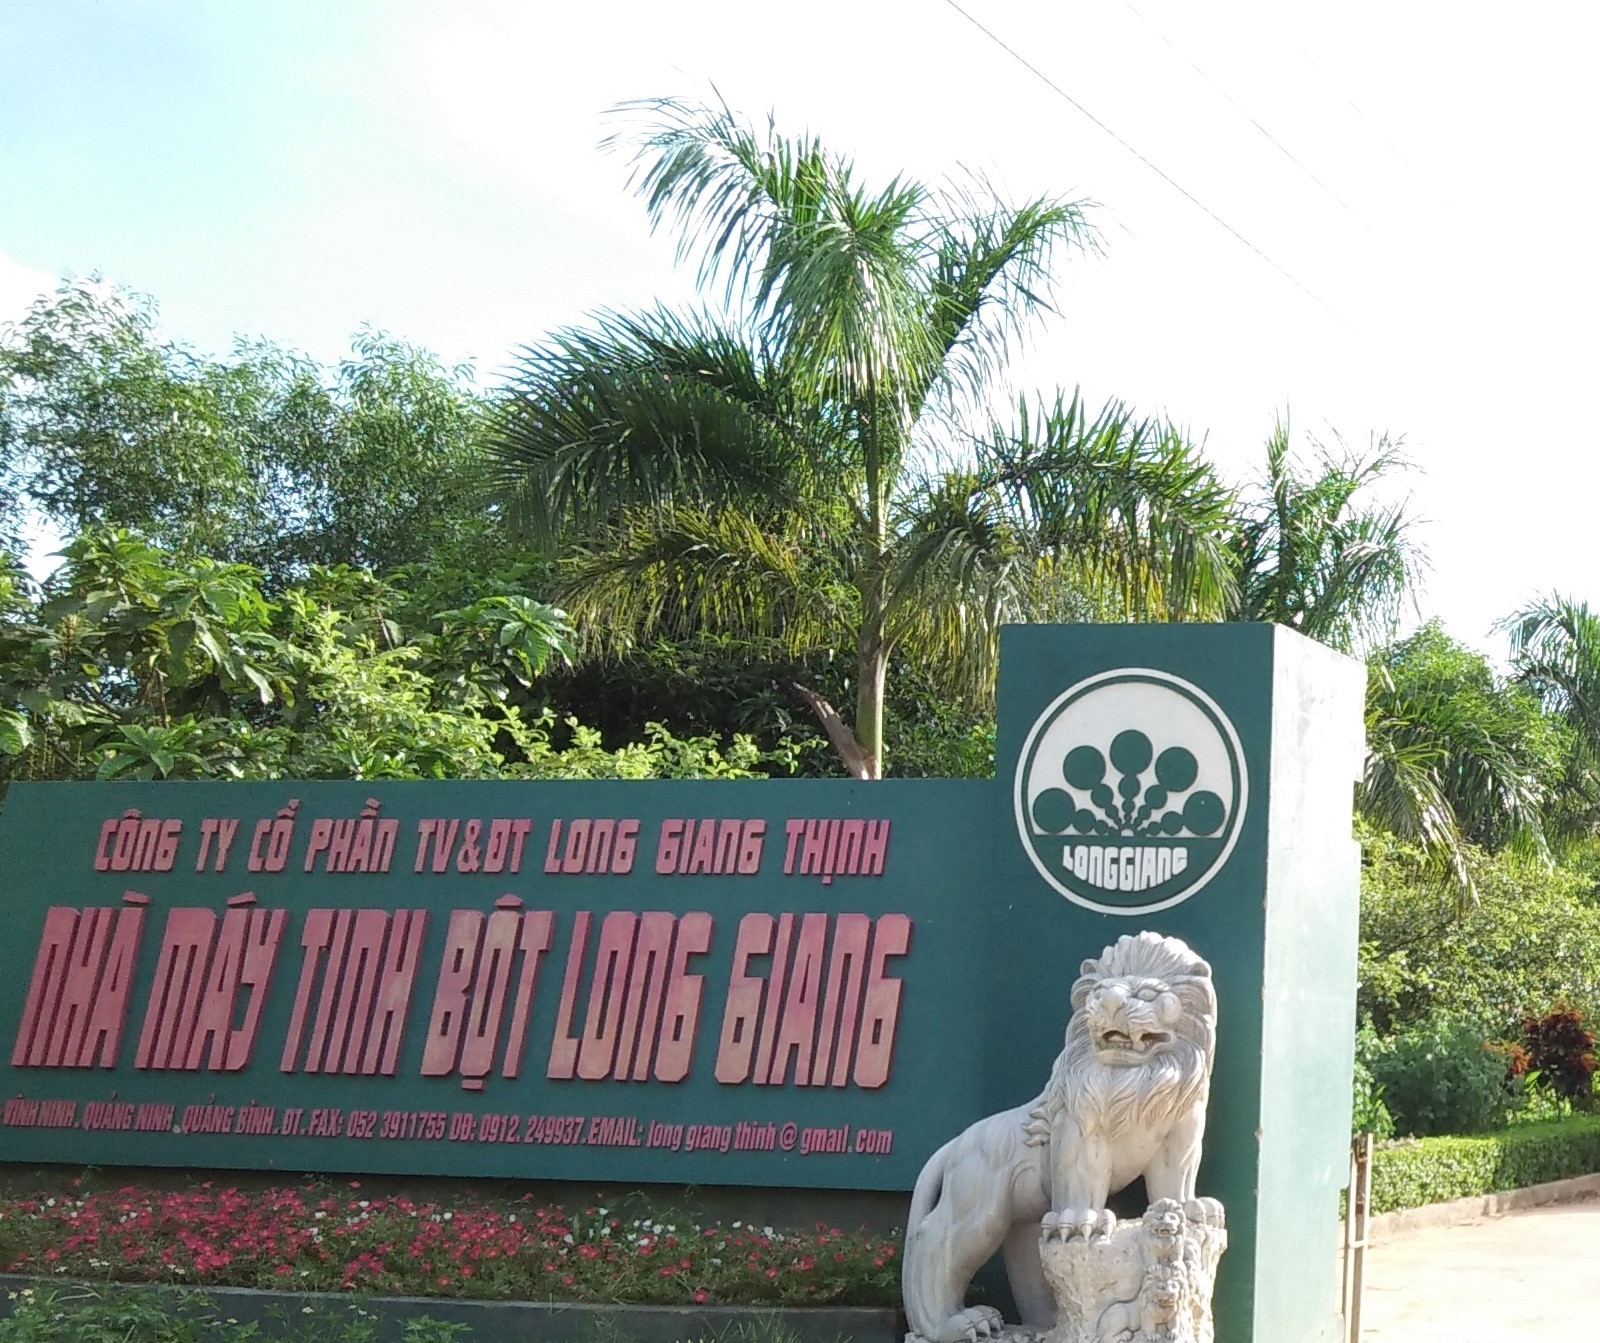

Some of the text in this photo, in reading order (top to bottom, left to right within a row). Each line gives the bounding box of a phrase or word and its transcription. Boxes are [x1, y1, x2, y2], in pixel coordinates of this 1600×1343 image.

[94, 808, 183, 872] CÔNG
[195, 818, 239, 873] TY
[304, 797, 400, 873] PHẦN
[544, 818, 641, 874] LONG
[655, 818, 767, 875] GIANG
[783, 818, 891, 884] THỊNH
[10, 890, 914, 1091] NHÀ MÁY TINH BỘT LONG GIANG
[347, 1110, 378, 1139] 052
[379, 1110, 448, 1140] 3911755
[646, 1119, 684, 1152] long
[685, 1123, 734, 1154] giang
